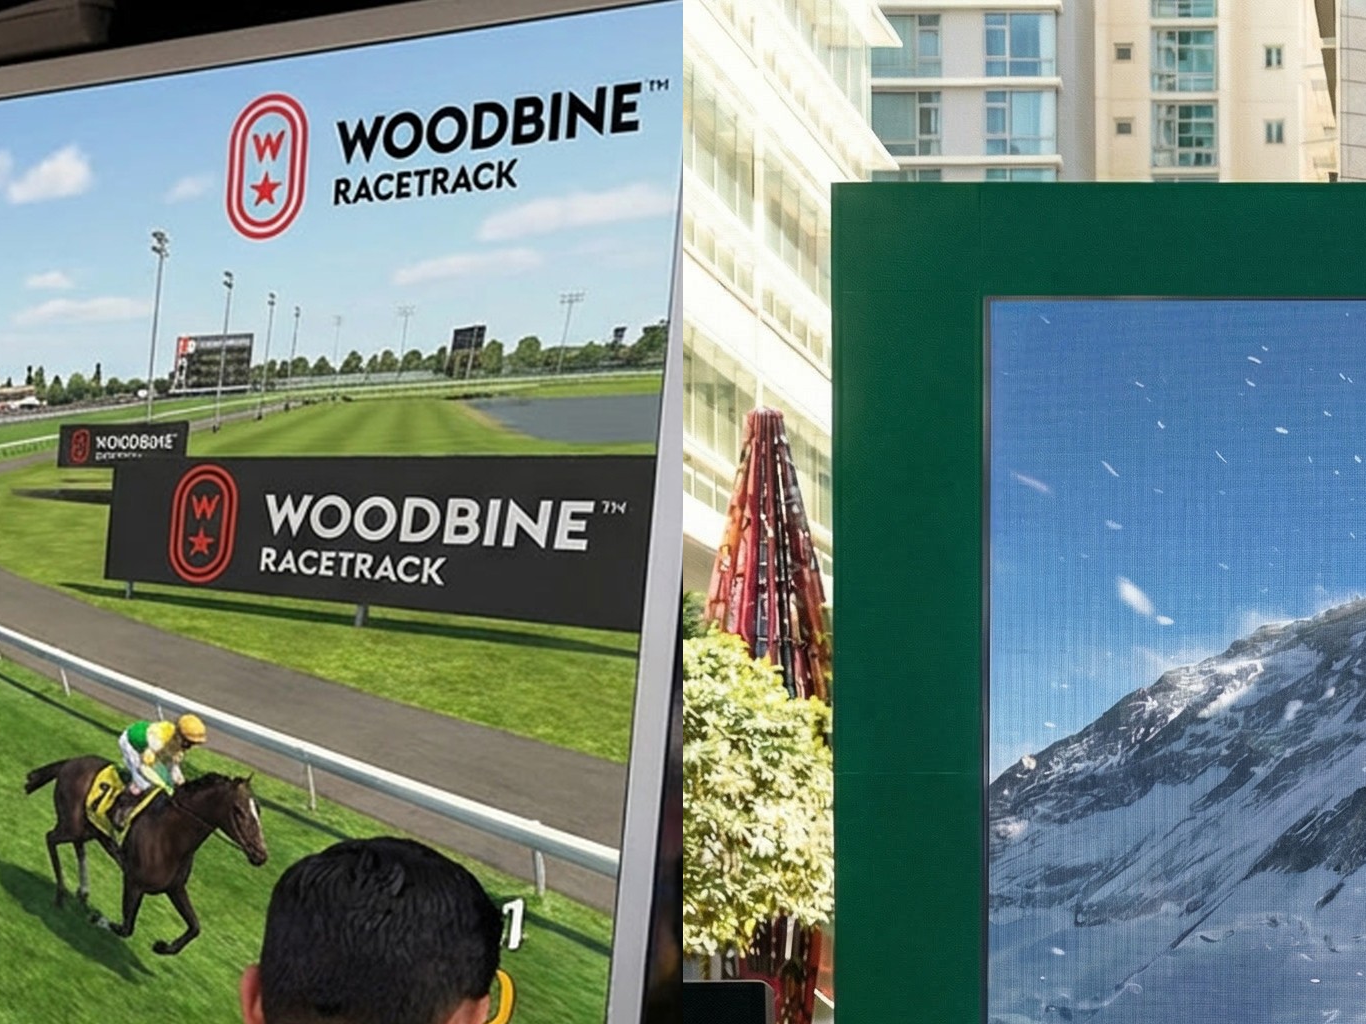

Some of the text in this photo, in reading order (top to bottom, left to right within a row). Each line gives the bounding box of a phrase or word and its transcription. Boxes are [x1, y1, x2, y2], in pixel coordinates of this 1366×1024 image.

[336, 81, 642, 165] WOODBINE
[333, 158, 518, 206] RACETRACK
[265, 494, 596, 551] WOODBINE
[259, 547, 447, 585] RACETRACK
